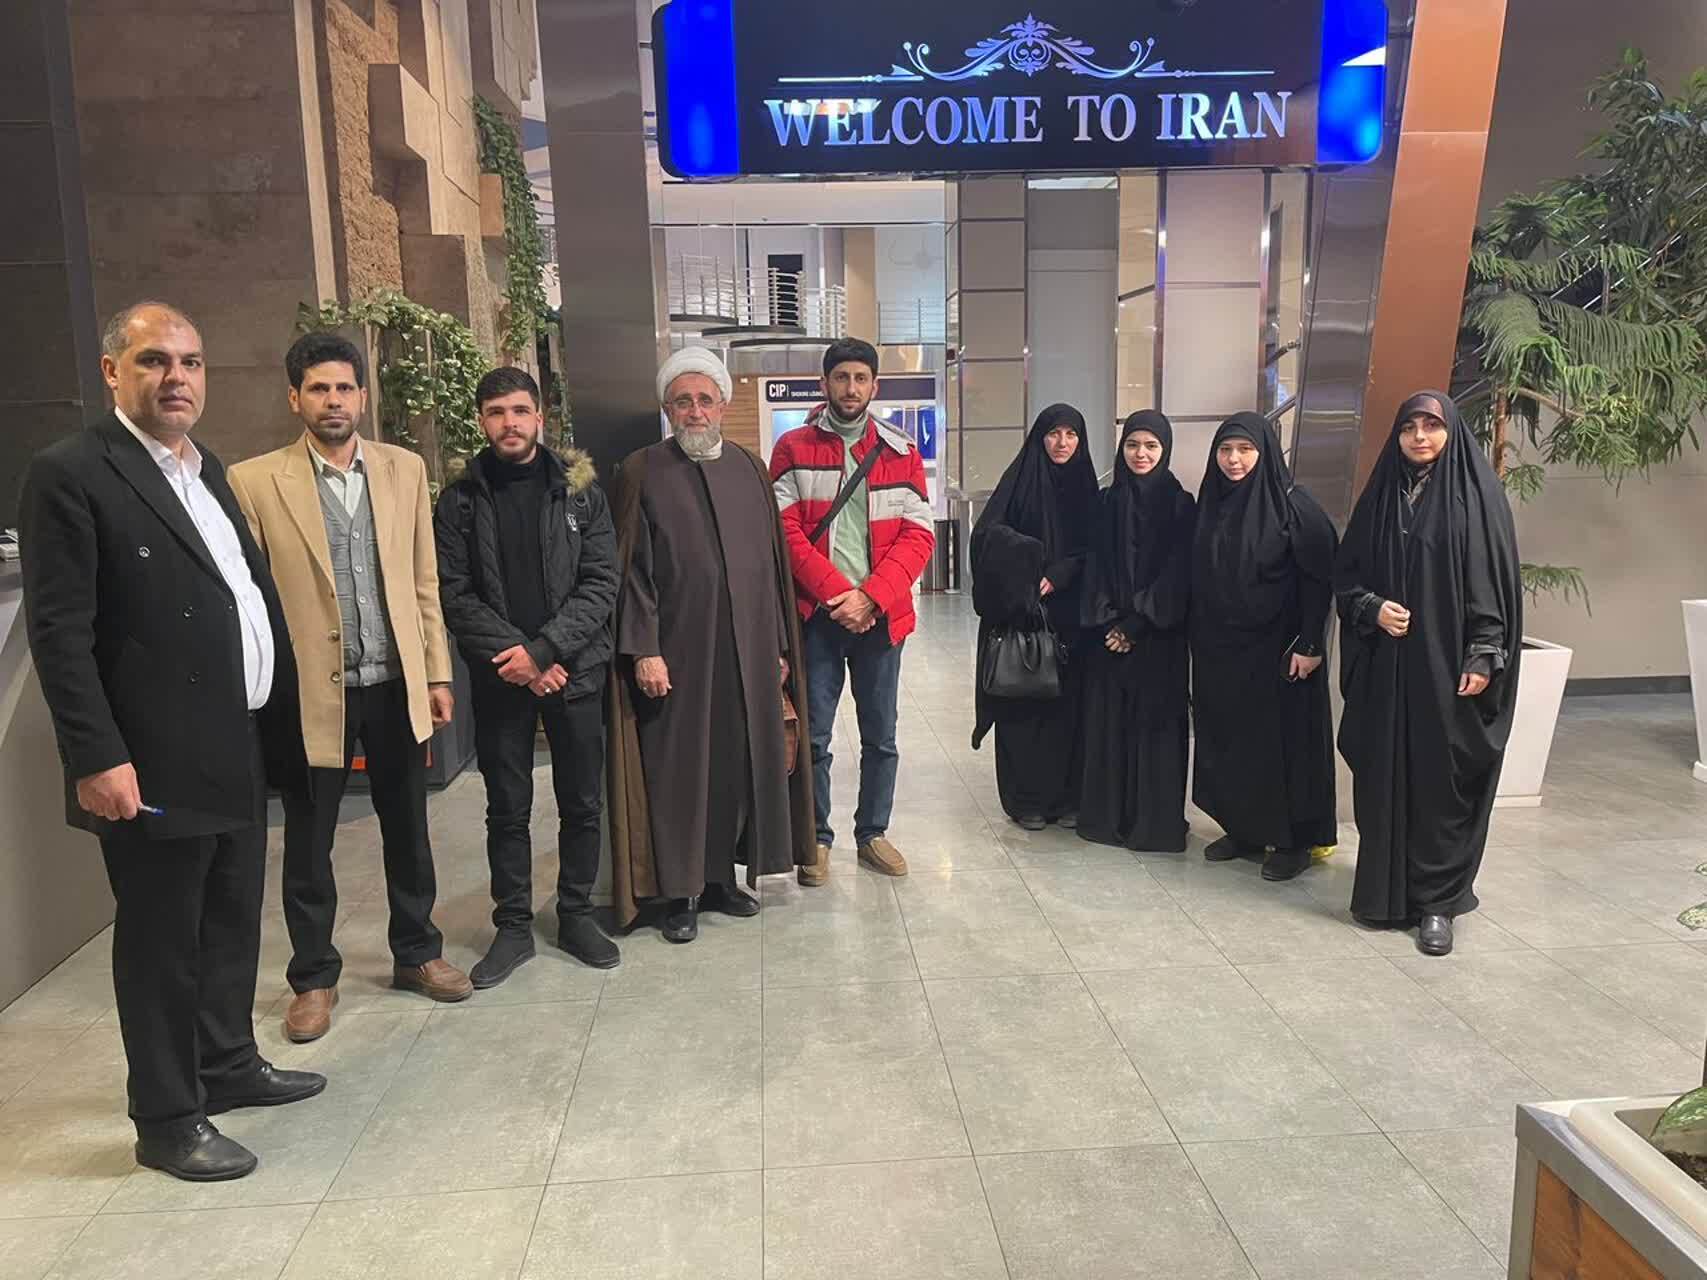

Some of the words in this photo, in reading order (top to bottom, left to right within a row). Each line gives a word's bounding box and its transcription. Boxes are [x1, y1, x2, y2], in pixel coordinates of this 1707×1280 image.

[763, 95, 1044, 147] WELCOME
[1067, 93, 1137, 142] TO
[1156, 91, 1293, 140] IRAN
[768, 383, 786, 398] CIP
